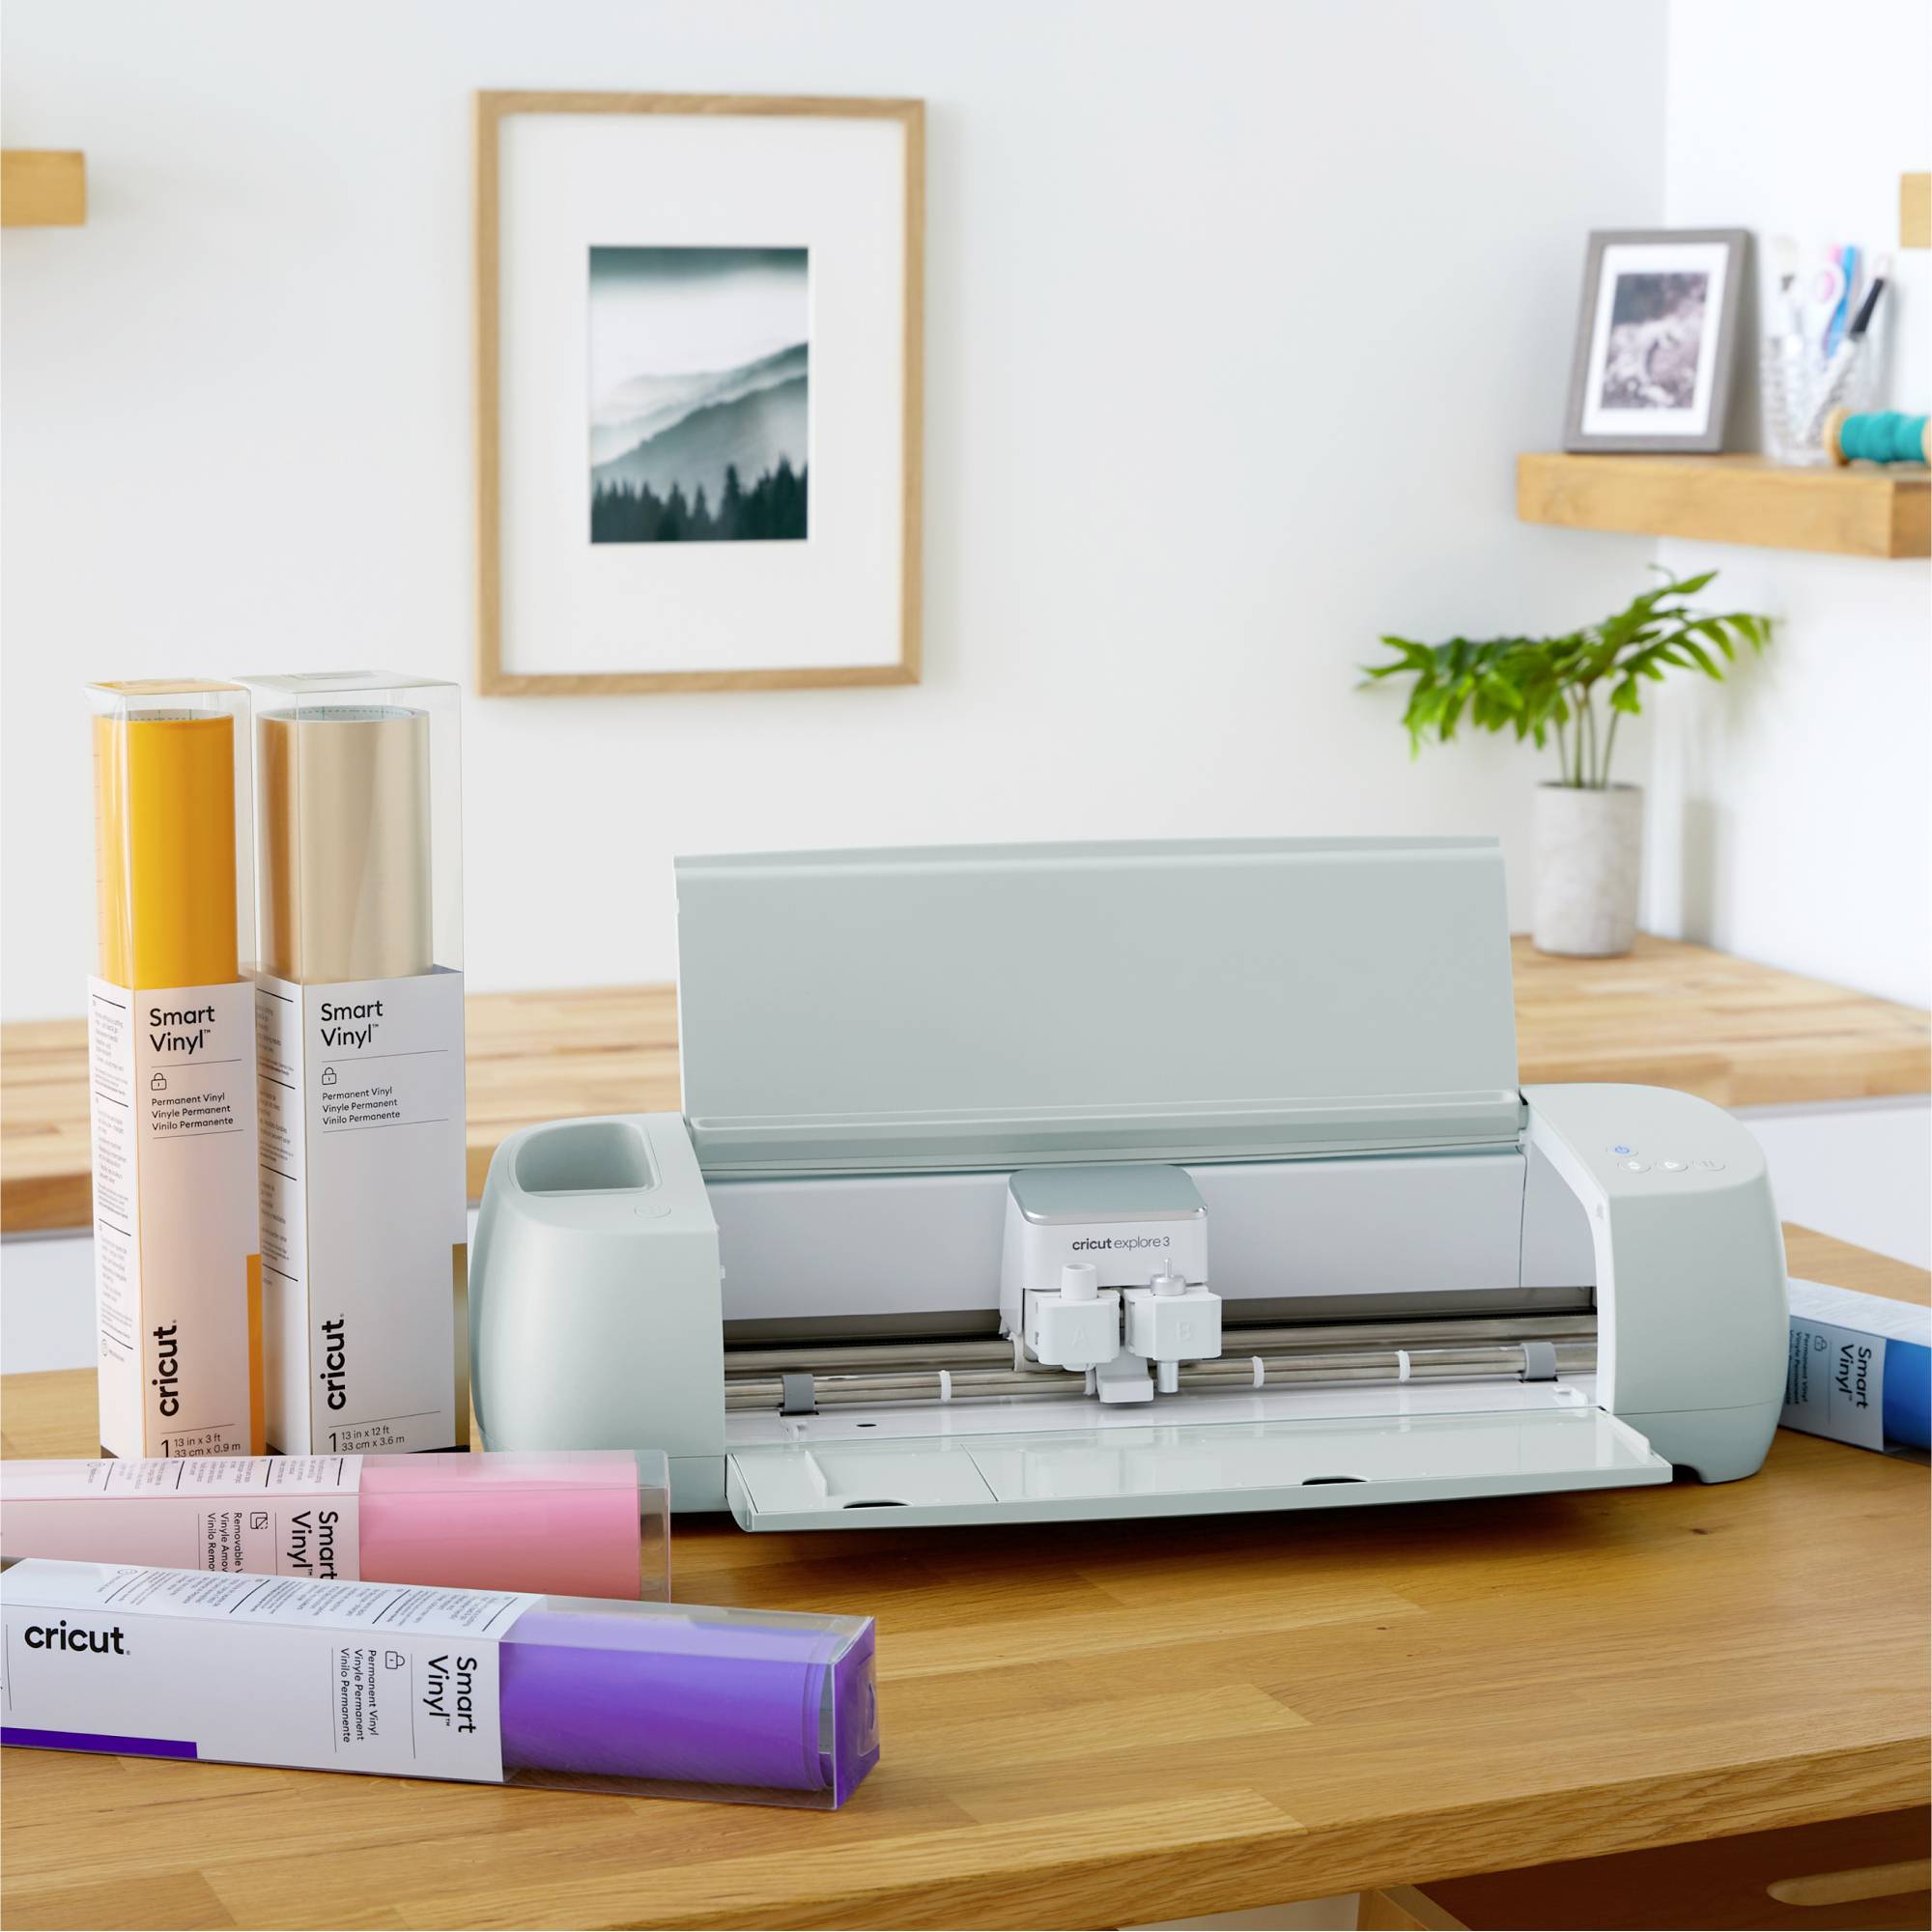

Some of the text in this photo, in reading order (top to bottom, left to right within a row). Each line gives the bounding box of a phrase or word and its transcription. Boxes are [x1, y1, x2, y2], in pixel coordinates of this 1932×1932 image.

[149, 1005, 215, 1028] Smart
[320, 1000, 384, 1022] Smart
[151, 1092, 225, 1107] Permanent Vinyl
[322, 1086, 393, 1101] Permanent Vinyl
[151, 1104, 231, 1121] Vinyle Permanent
[322, 1098, 398, 1115] Vinyle Permanent
[151, 1116, 234, 1132] Vinilo Permanente
[322, 1110, 401, 1125] Vinilo Permanente
[1072, 1236, 1170, 1251] cricut explore 3
[1856, 1346, 1872, 1409] Smart
[174, 1437, 185, 1447] 13
[186, 1437, 195, 1446] in
[206, 1435, 212, 1443] 3
[213, 1433, 221, 1442] ft
[341, 1431, 352, 1440] 13
[354, 1430, 362, 1438] in
[371, 1427, 381, 1436] 12
[383, 1425, 390, 1435] ft
[160, 1439, 169, 1458] 1
[174, 1449, 186, 1458] 33
[188, 1448, 204, 1457] cm
[213, 1443, 229, 1453] 0.9
[328, 1433, 336, 1453] 1
[341, 1441, 354, 1452] 33
[355, 1441, 370, 1450] cm
[380, 1435, 394, 1446] 3.6
[208, 1513, 216, 1540] Vinilo
[218, 1512, 230, 1543] Vinyle
[234, 1512, 243, 1567] Removable
[319, 1511, 338, 1579] Smart
[340, 1647, 351, 1743] Vinilo Permanente
[353, 1648, 364, 1741] Vinyle Permanent
[367, 1649, 380, 1736] Permanent Vinyl
[456, 1657, 477, 1734] Smart
